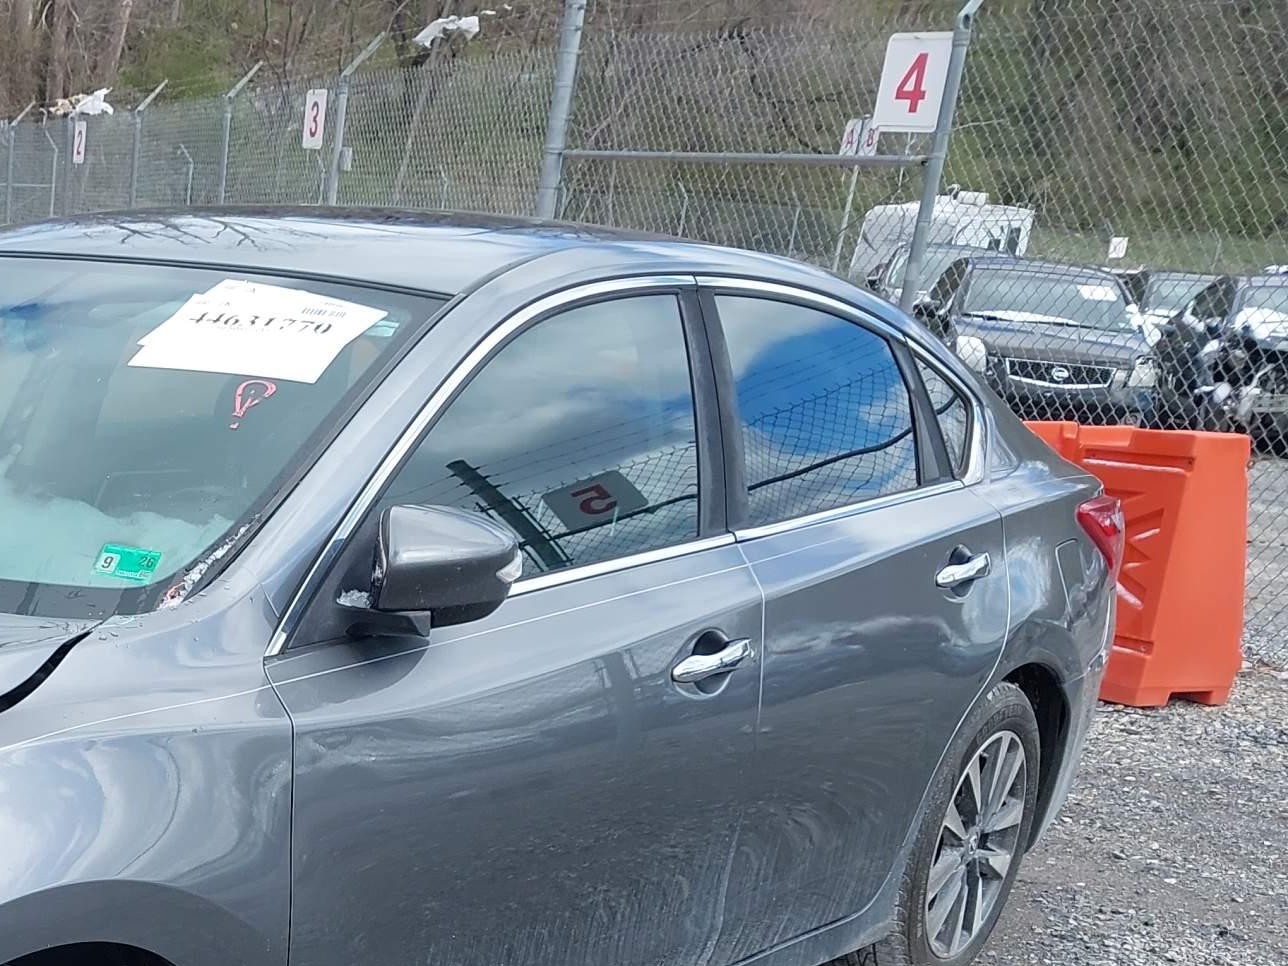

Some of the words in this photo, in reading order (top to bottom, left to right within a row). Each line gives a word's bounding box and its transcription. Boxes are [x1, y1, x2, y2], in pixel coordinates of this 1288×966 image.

[895, 52, 929, 113] 4
[309, 101, 319, 138] 3
[75, 129, 86, 156] 2
[189, 311, 334, 335] 44631770
[101, 556, 114, 569] 9
[138, 556, 154, 569] 26
